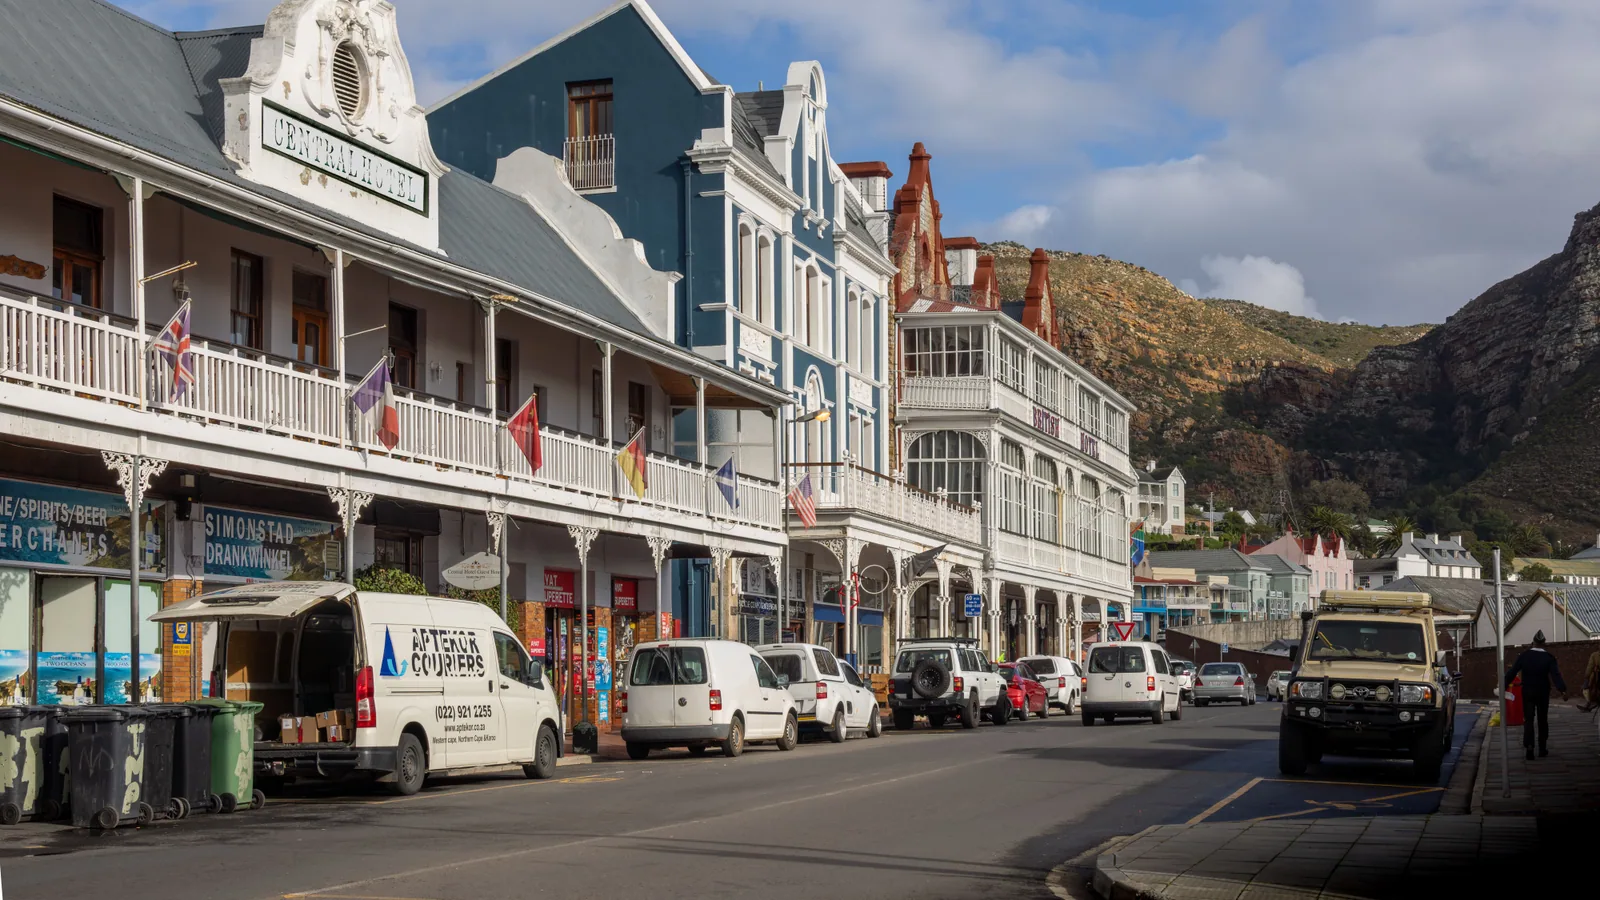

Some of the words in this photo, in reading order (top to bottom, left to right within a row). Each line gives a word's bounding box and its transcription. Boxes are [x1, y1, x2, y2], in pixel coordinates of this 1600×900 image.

[274, 118, 358, 178] CENTRAL
[361, 155, 416, 203] HOTEL
[1033, 405, 1060, 439] BRITISH
[1080, 432, 1100, 460] HOTEL
[205, 512, 294, 545] SIMONSTAD
[206, 542, 293, 571] DRANKWINKEL
[544, 574, 558, 587] YAT
[412, 628, 480, 654] APTEKOR
[411, 652, 485, 677] COURIERS
[435, 705, 456, 722] (022)
[457, 705, 472, 718] 921
[473, 705, 492, 717] 2255
[432, 736, 447, 744] Western
[458, 735, 473, 743] Northern
[473, 734, 483, 743] Cape
[444, 723, 485, 733] www.aptekor.co.za
